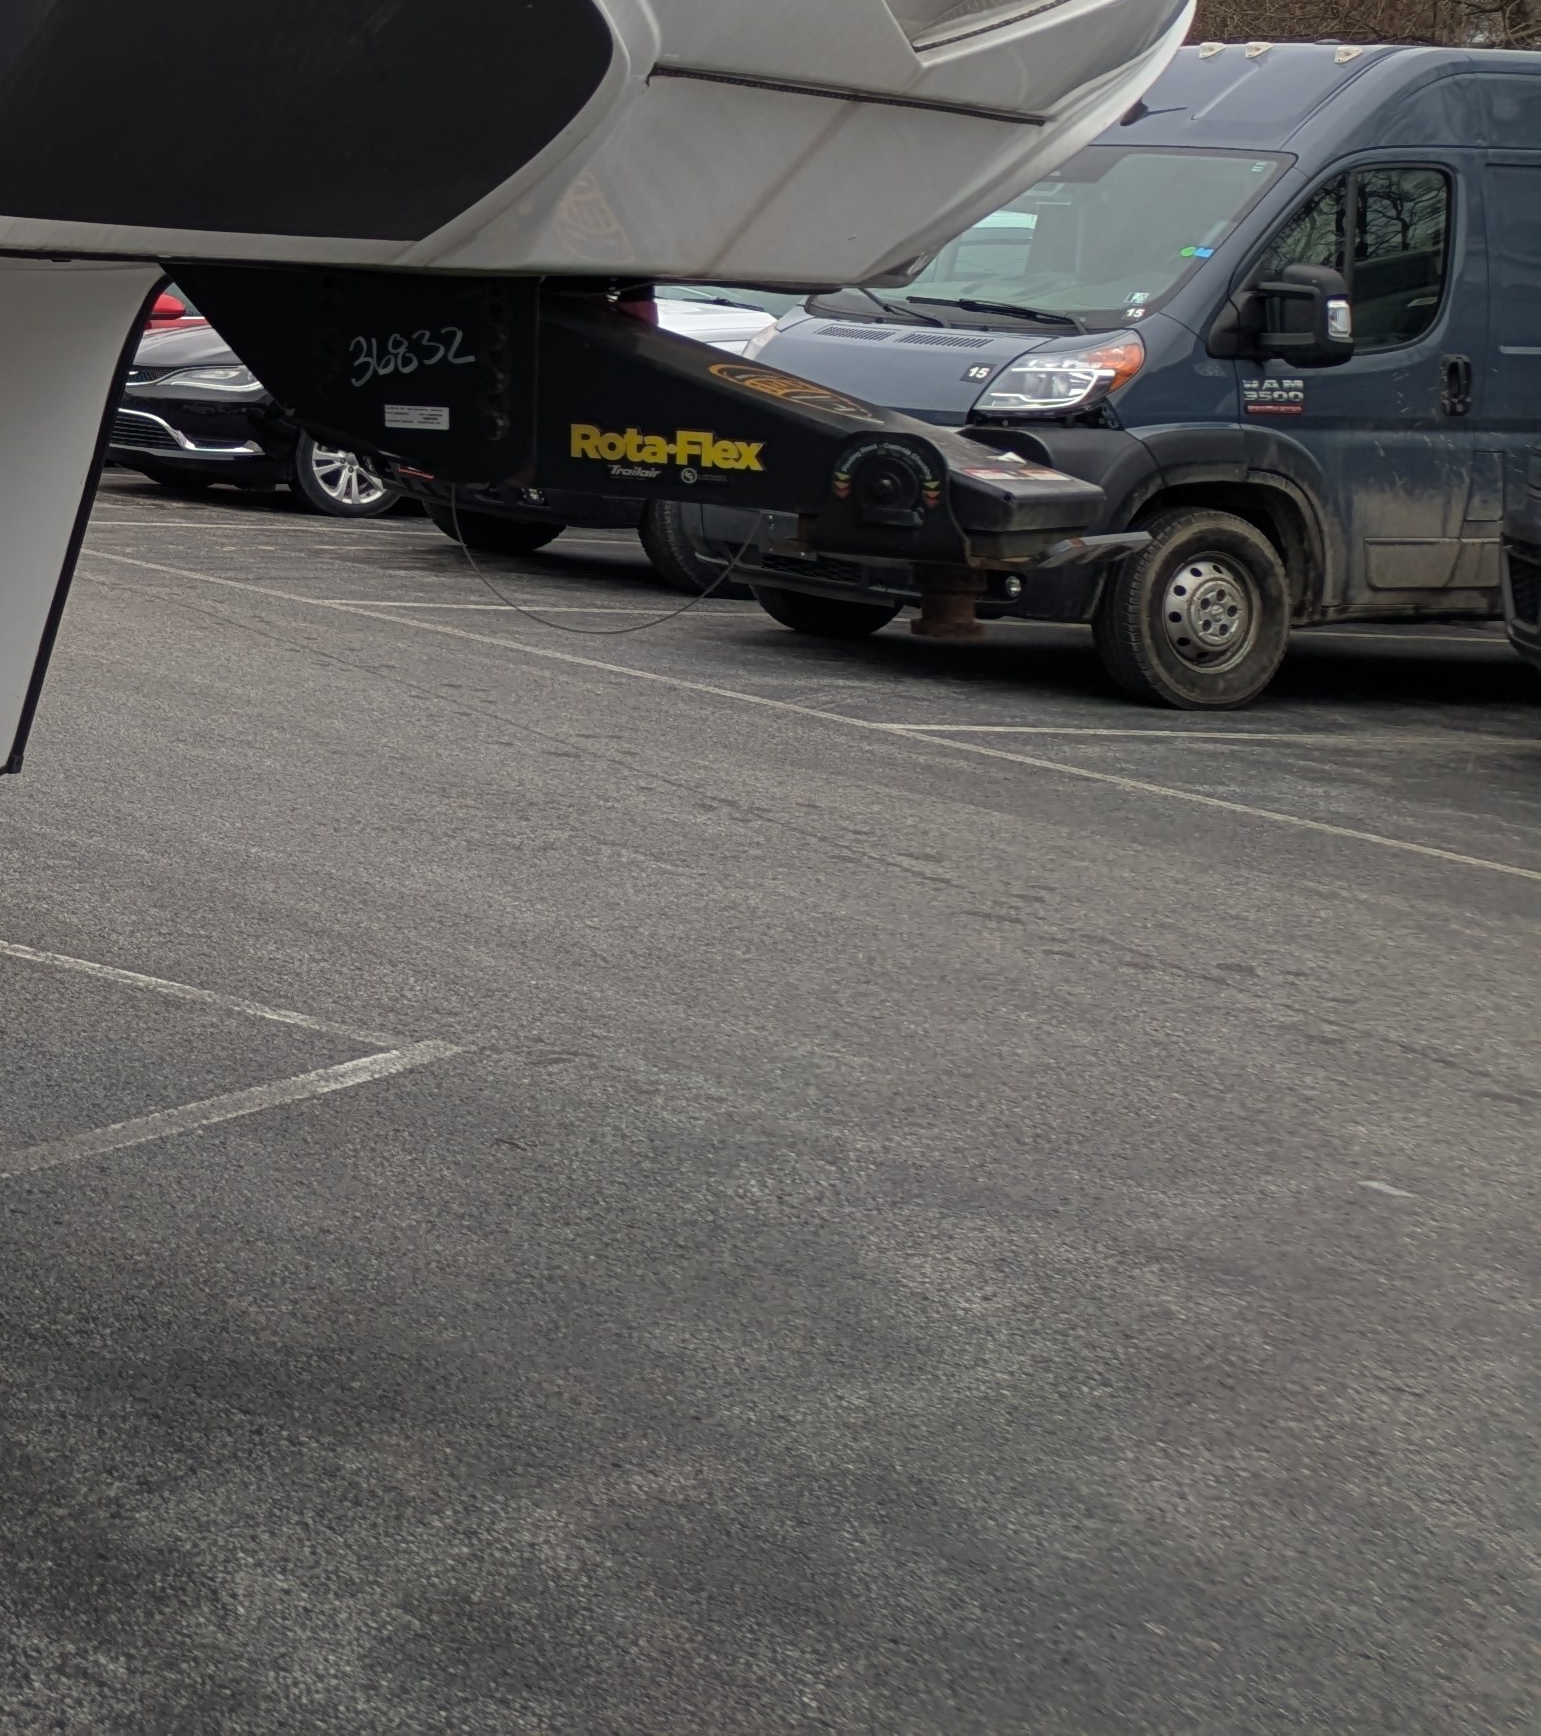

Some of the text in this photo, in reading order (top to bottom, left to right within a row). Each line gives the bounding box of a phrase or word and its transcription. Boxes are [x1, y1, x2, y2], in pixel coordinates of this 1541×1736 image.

[348, 326, 476, 388] 36832
[968, 366, 991, 379] 15
[1242, 379, 1304, 390] RAM
[1243, 390, 1305, 401] 3500
[608, 464, 662, 479] Trailair
